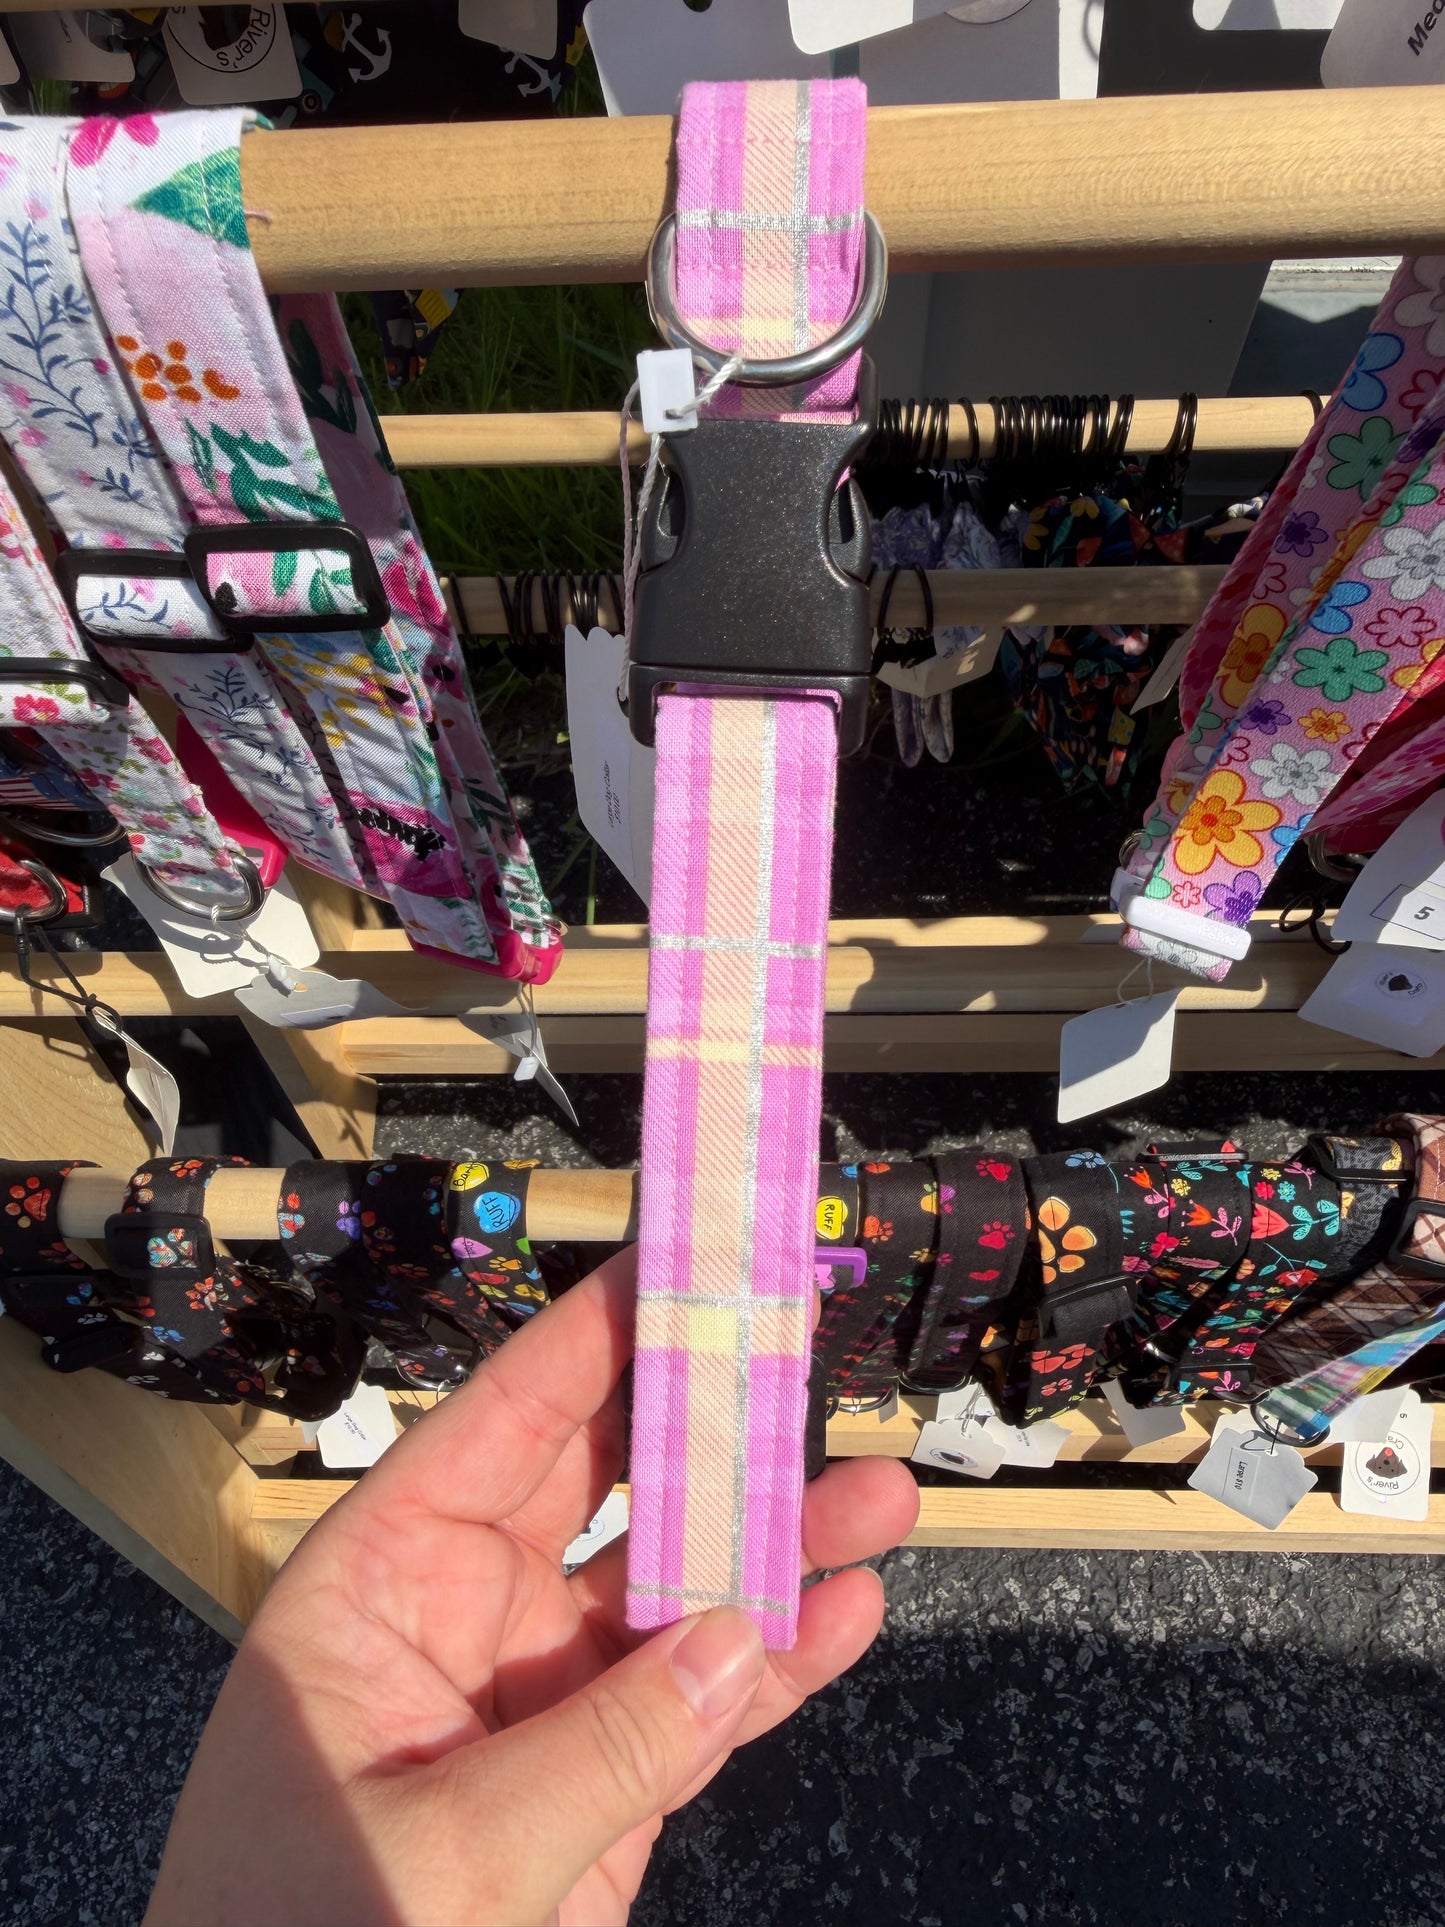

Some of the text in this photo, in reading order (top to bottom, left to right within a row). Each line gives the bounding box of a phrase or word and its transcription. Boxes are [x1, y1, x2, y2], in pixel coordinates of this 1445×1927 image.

[216, 7, 271, 69] River's
[1414, 905, 1435, 921] 5
[481, 1196, 509, 1229] RUFF
[824, 1203, 836, 1231] RUFF
[1234, 1461, 1248, 1491] Large $10
[1366, 1475, 1399, 1490] River's
